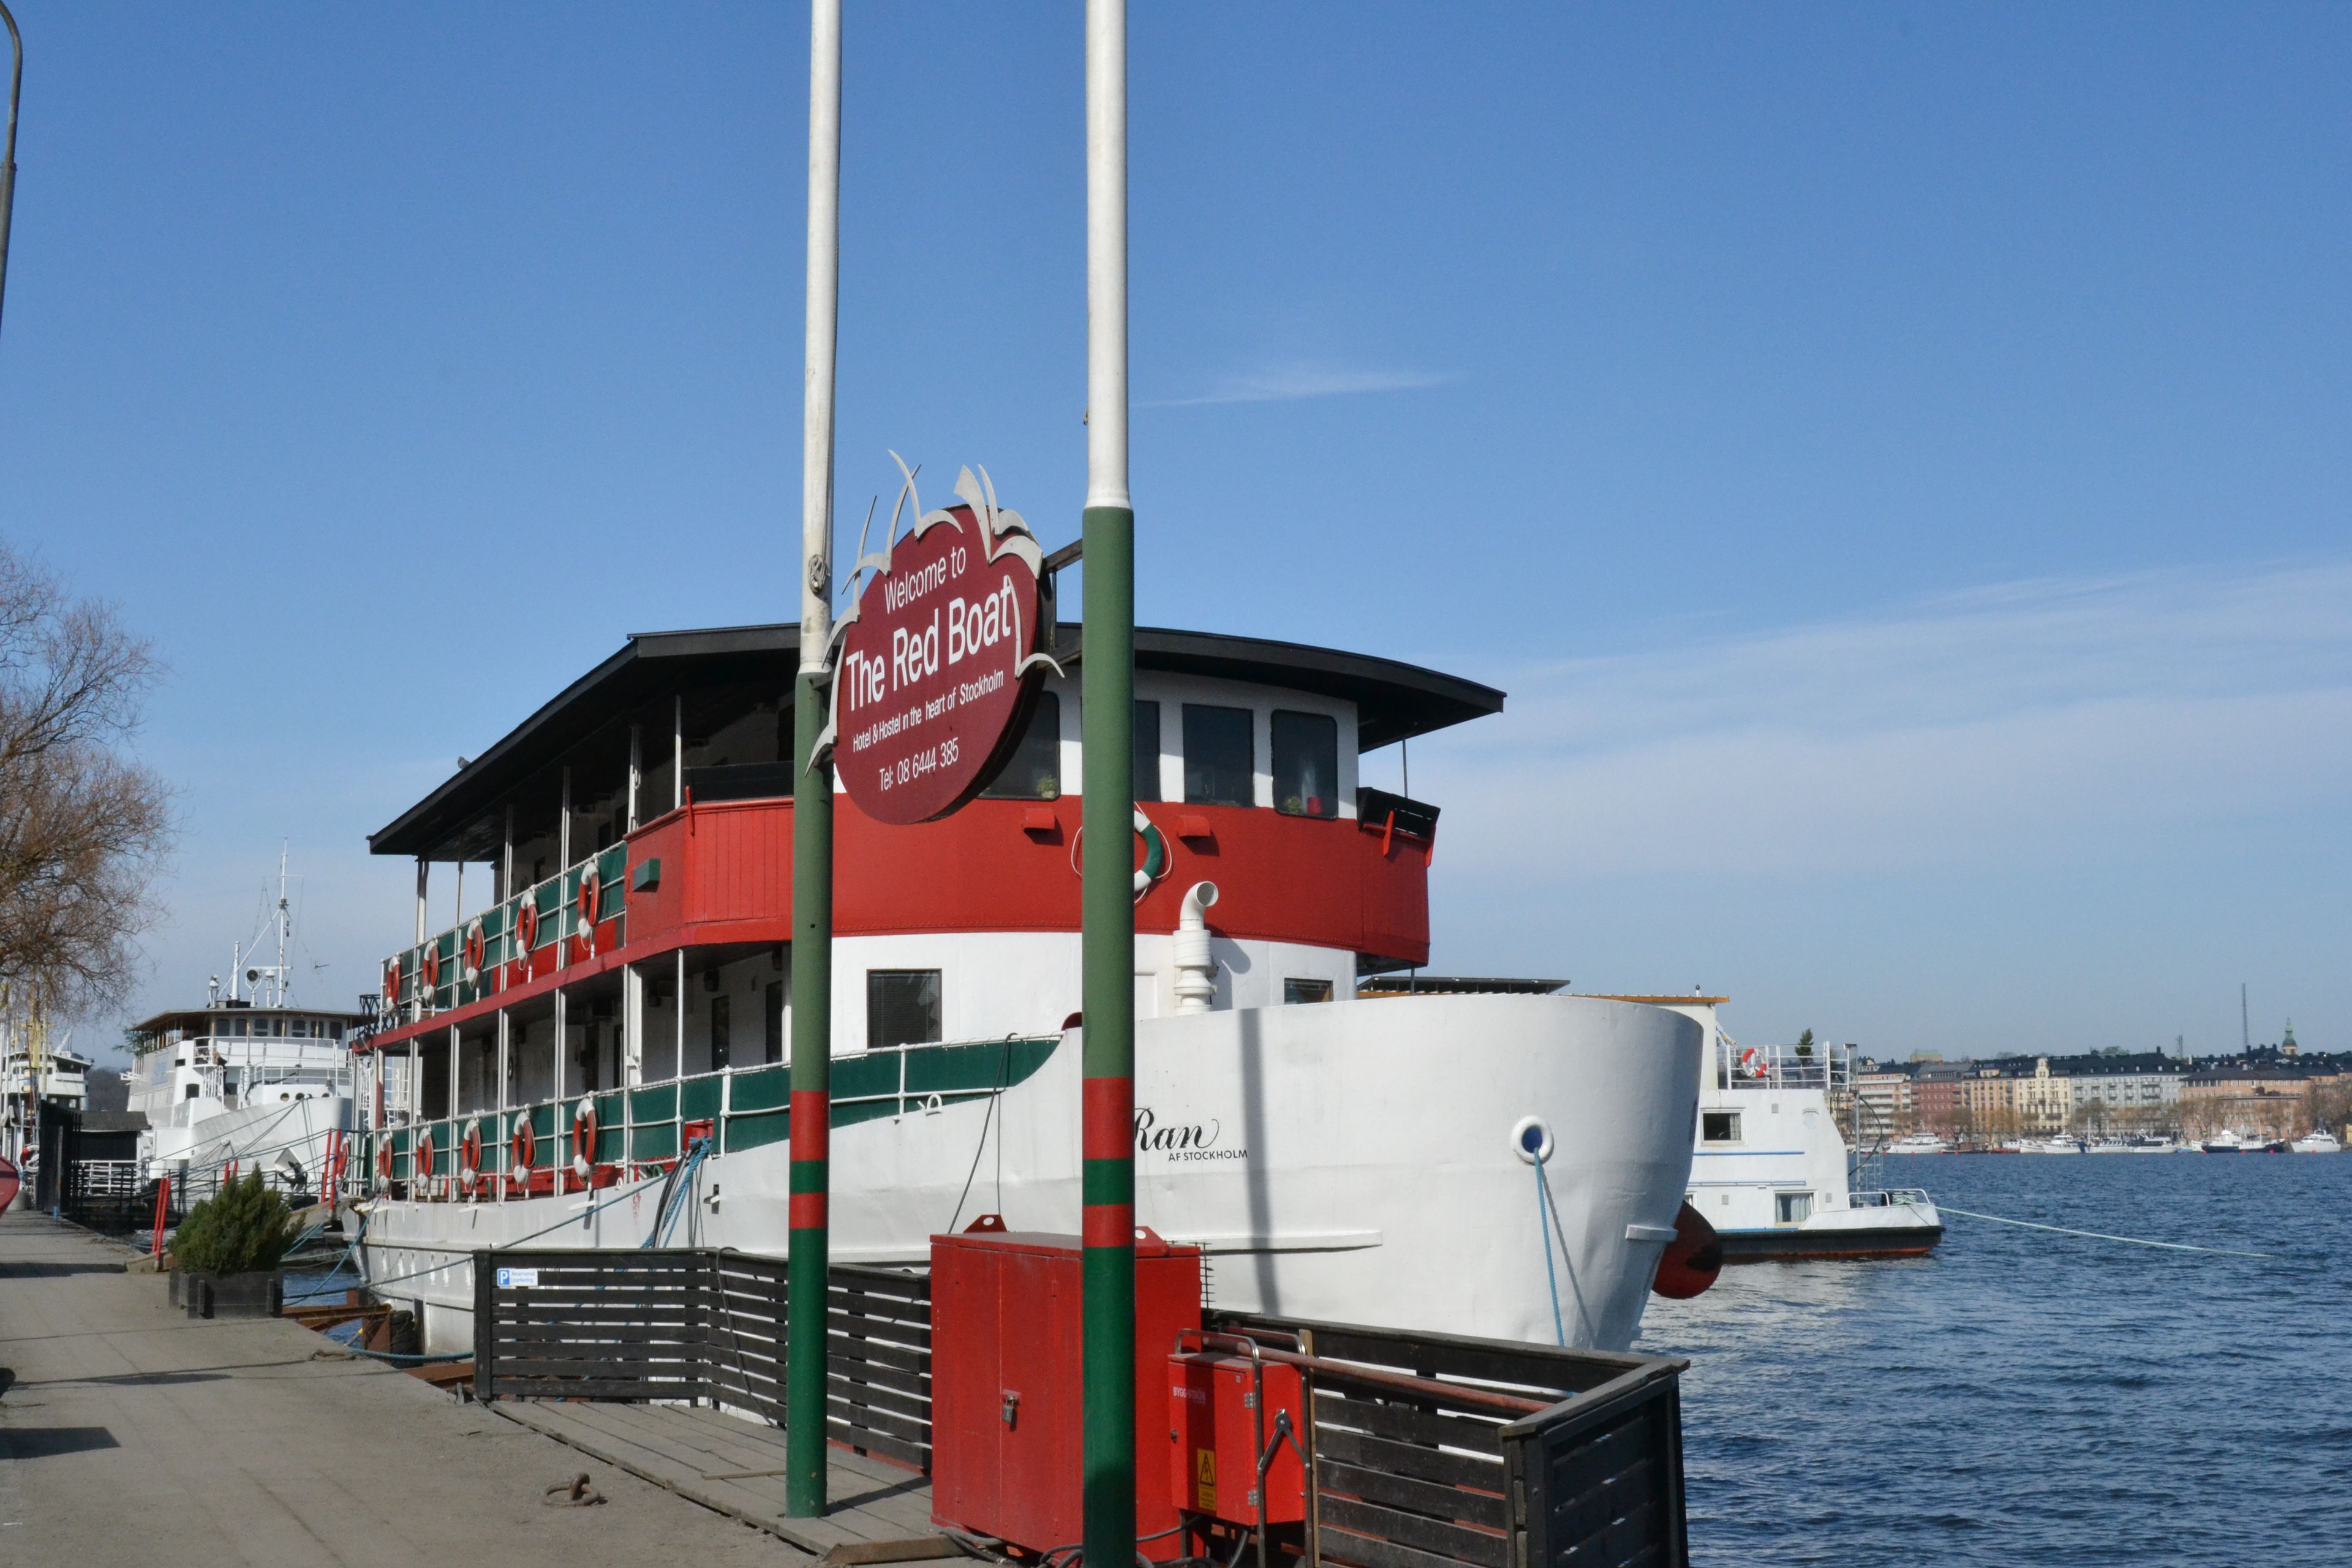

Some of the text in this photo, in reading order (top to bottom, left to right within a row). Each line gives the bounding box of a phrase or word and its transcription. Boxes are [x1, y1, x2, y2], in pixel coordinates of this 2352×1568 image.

[884, 547, 967, 614] Welcome to
[846, 575, 1011, 711] The Red Boat
[853, 669, 1004, 753] Hotel & Hostel in the heart of Stockholm
[880, 737, 959, 791] Tel: 08 6444 385
[1135, 1107, 1219, 1152] Ran
[1169, 1150, 1248, 1161] AF STOCKHOLM
